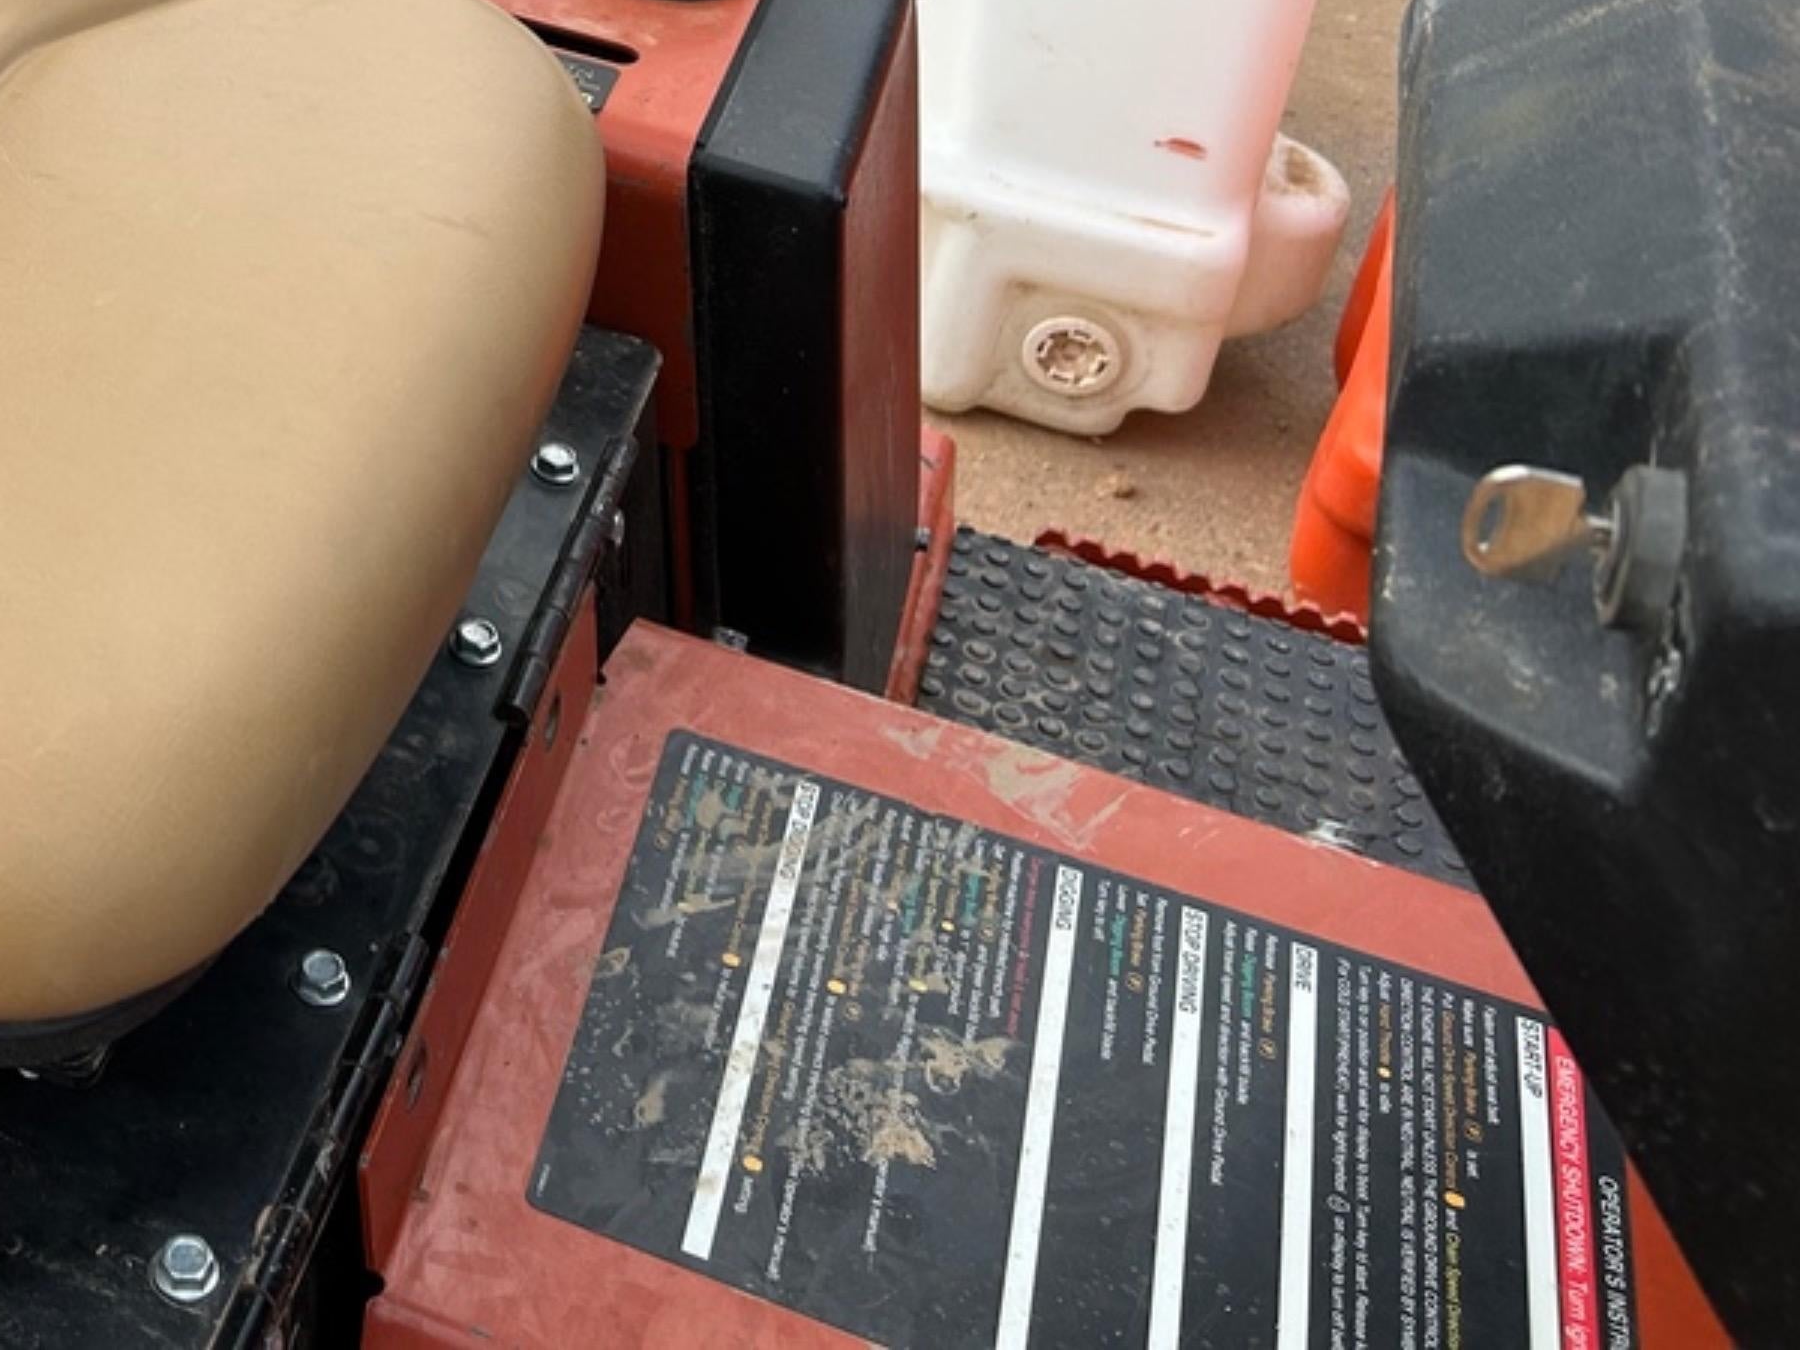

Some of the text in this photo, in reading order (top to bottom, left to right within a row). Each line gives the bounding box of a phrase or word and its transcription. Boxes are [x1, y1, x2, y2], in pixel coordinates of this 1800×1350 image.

[1054, 870, 1078, 932] DIGGING
[1177, 910, 1203, 1015] STOP DRIVING
[1294, 947, 1312, 992] DRIVE
[1358, 964, 1370, 986] Turn
[1358, 1003, 1370, 1015] to
[1400, 977, 1413, 1032] DIRECTION
[1421, 984, 1434, 1005] THE
[1219, 1004, 1232, 1024] and
[1422, 1004, 1434, 1045] ENGINE
[1462, 998, 1475, 1025] Make
[1238, 1019, 1251, 1040] and
[1442, 1010, 1454, 1048] Ground
[1400, 1031, 1413, 1084] CONTROL
[1422, 1045, 1434, 1071] WILL
[1443, 1046, 1455, 1073] Drive
[1485, 1036, 1497, 1056] and
[1520, 1019, 1543, 1099] START-UP
[1357, 1066, 1370, 1088] and
[1464, 1048, 1477, 1088] Parking
[1485, 1055, 1497, 1084] adjust
[1357, 1087, 1370, 1108] wait
[1400, 1083, 1413, 1106] ARE
[1422, 1071, 1435, 1095] NOT
[1443, 1071, 1455, 1105] Speed
[1486, 1083, 1498, 1105] seat
[1335, 1093, 1348, 1114] wait
[1422, 1094, 1435, 1131] START
[1464, 1086, 1478, 1116] Brake
[1555, 1055, 1580, 1163] EMERGENCY
[1335, 1113, 1347, 1130] for
[1357, 1107, 1370, 1125] for
[1444, 1104, 1456, 1152] Direction
[1356, 1124, 1370, 1161] display
[1423, 1130, 1435, 1176] UNLESS
[1356, 1160, 1369, 1174] to
[1444, 1151, 1457, 1190] Control
[1423, 1175, 1436, 1200] THE
[1332, 1214, 1346, 1232] on
[1355, 1201, 1369, 1229] Turn
[1423, 1199, 1436, 1254] GROUND
[1445, 1208, 1458, 1230] and
[1561, 1163, 1587, 1276] SHUTDOWN:
[1331, 1231, 1345, 1273] display
[1445, 1230, 1458, 1266] Chain
[1598, 1173, 1630, 1350] OPERATOR'S INSTR
[1331, 1271, 1345, 1286] to
[1424, 1252, 1437, 1290] DRIVE
[1446, 1265, 1459, 1302] Speed
[1330, 1284, 1344, 1311] turn
[1567, 1278, 1590, 1323] Turn
